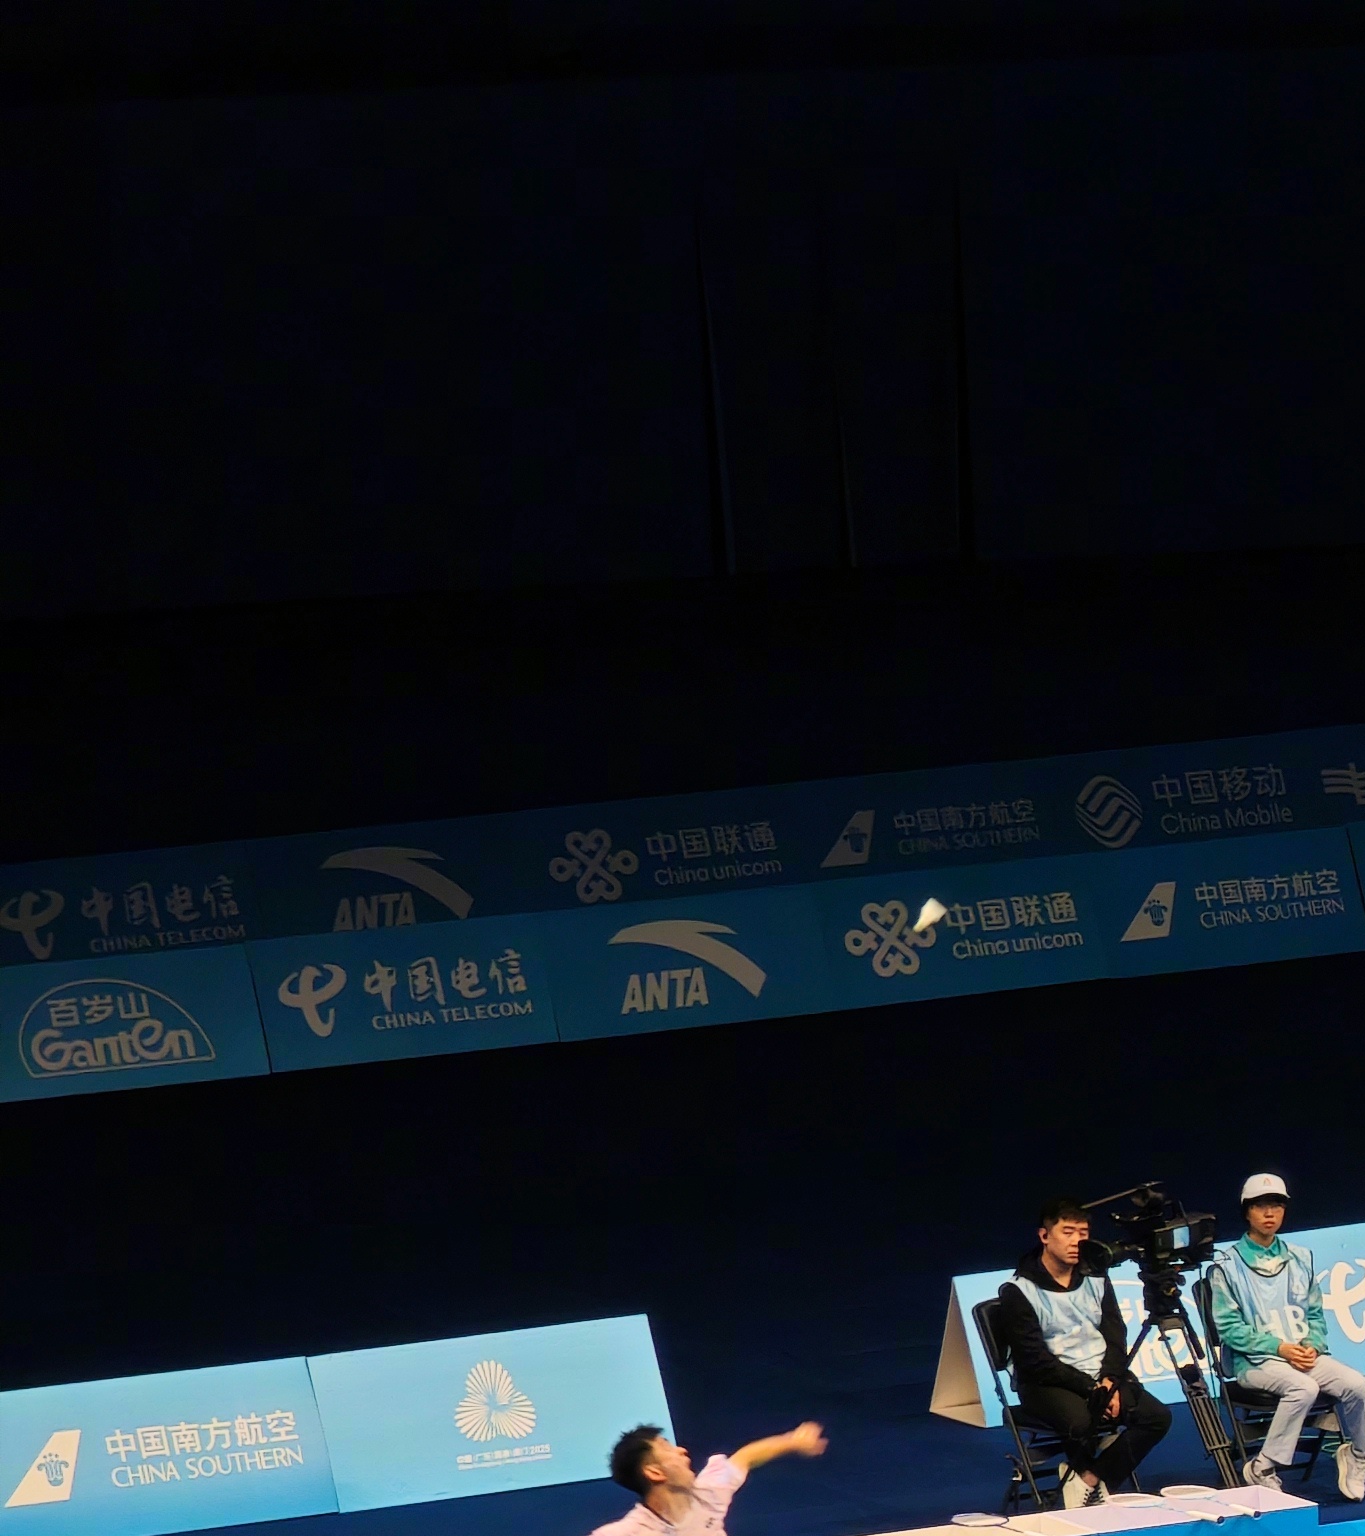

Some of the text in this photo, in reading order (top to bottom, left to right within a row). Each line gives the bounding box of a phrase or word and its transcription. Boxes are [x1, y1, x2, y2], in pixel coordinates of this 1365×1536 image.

[1152, 763, 1285, 808] 中国移动
[894, 799, 1036, 835] 中国南方航空
[1160, 804, 1293, 835] China Mobile
[646, 821, 778, 862] 中国联通
[654, 857, 782, 885] China unicom
[1194, 869, 1337, 908] 中国南方航空
[81, 875, 240, 935] 中国电信
[332, 892, 416, 932] ANTA
[946, 892, 1078, 934] 中国联通
[1200, 898, 1344, 930] CHINA SOUTHERN
[89, 923, 246, 953] CHINA TELECOM
[952, 930, 1083, 960] China unicom
[364, 948, 527, 1011] 中国电信
[622, 967, 709, 1015] ANTA
[47, 993, 149, 1028] 百岁山
[371, 1000, 533, 1030] CHINA TELECOM
[105, 1410, 299, 1460] 中国南方航空
[111, 1445, 303, 1488] CHINA SOUTHERN
